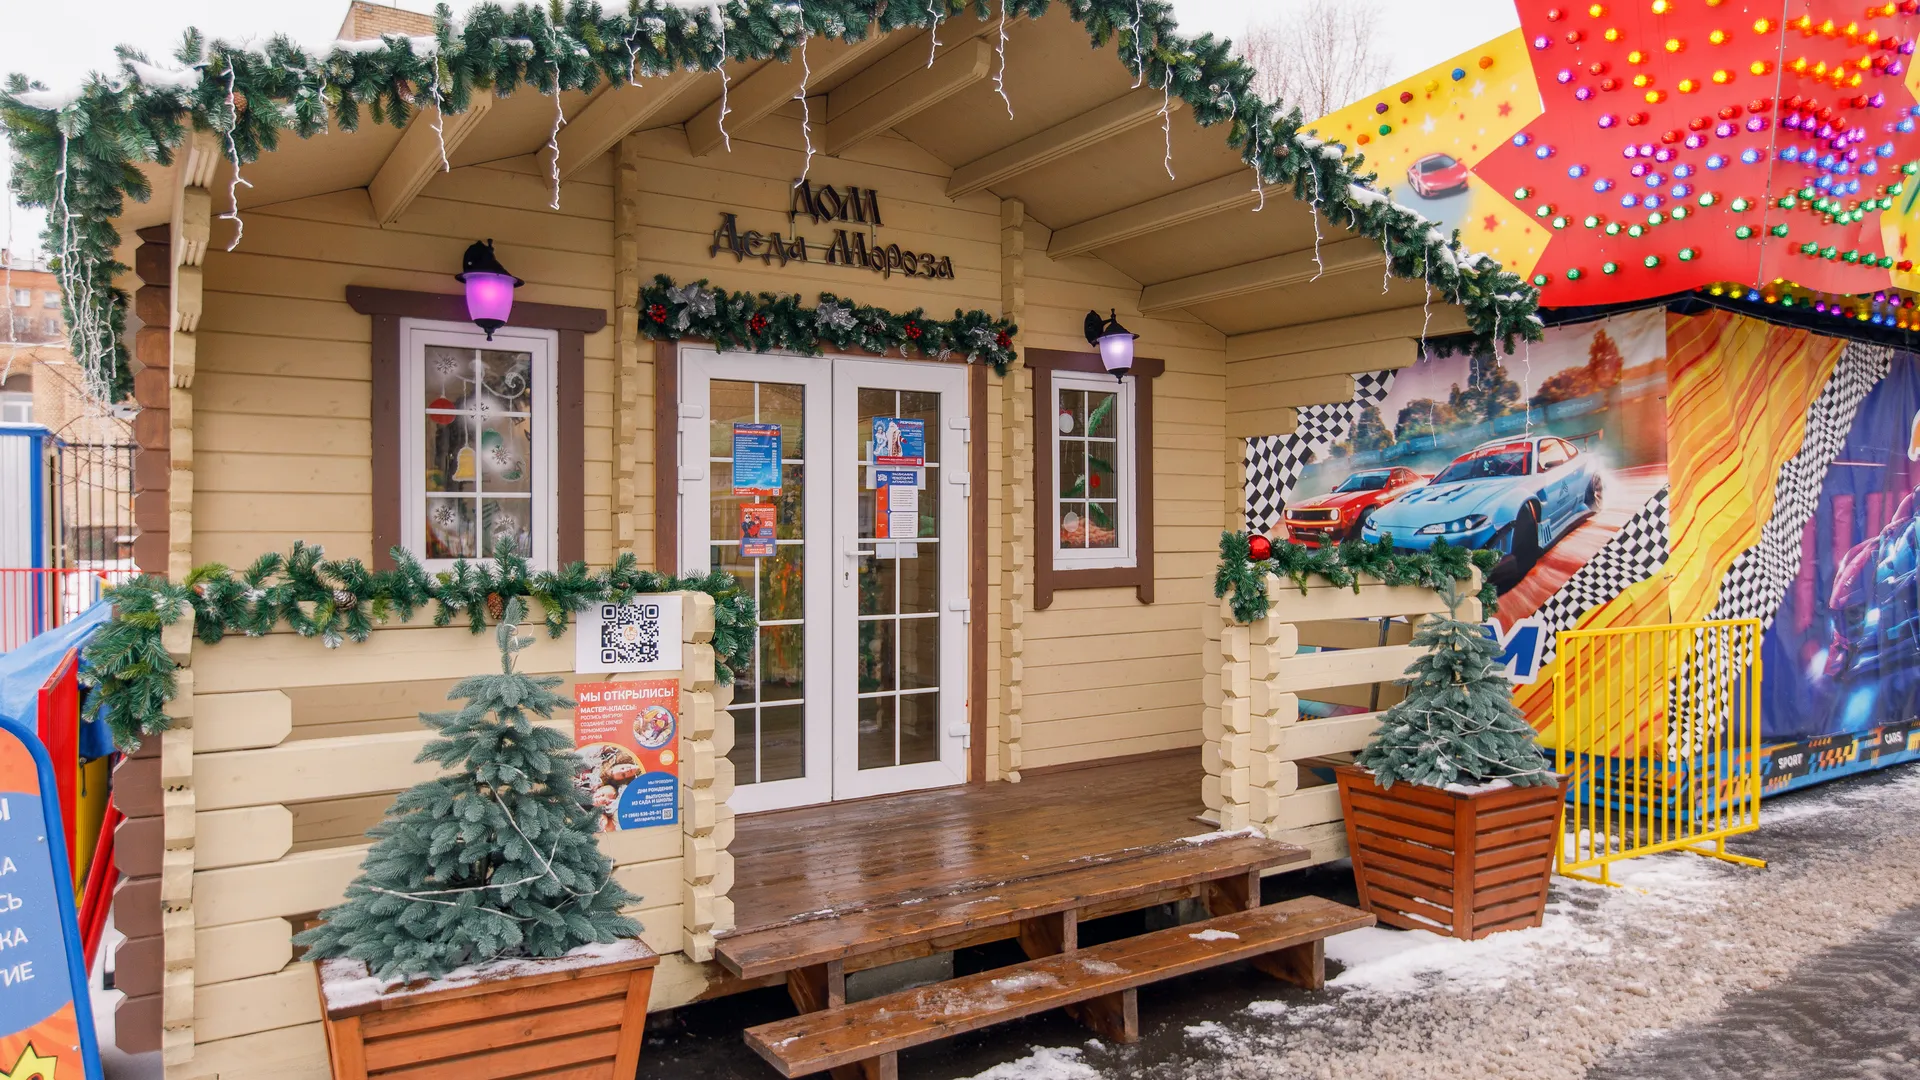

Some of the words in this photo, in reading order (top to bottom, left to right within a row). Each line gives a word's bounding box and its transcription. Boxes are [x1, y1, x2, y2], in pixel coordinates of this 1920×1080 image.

[709, 212, 807, 268] Деда
[826, 229, 955, 279] Мороза
[580, 692, 600, 702] МЫ
[604, 688, 674, 700] ОТКРЫЛИСЬ!
[1884, 731, 1903, 744] CARS
[1778, 753, 1803, 770] SPORT
